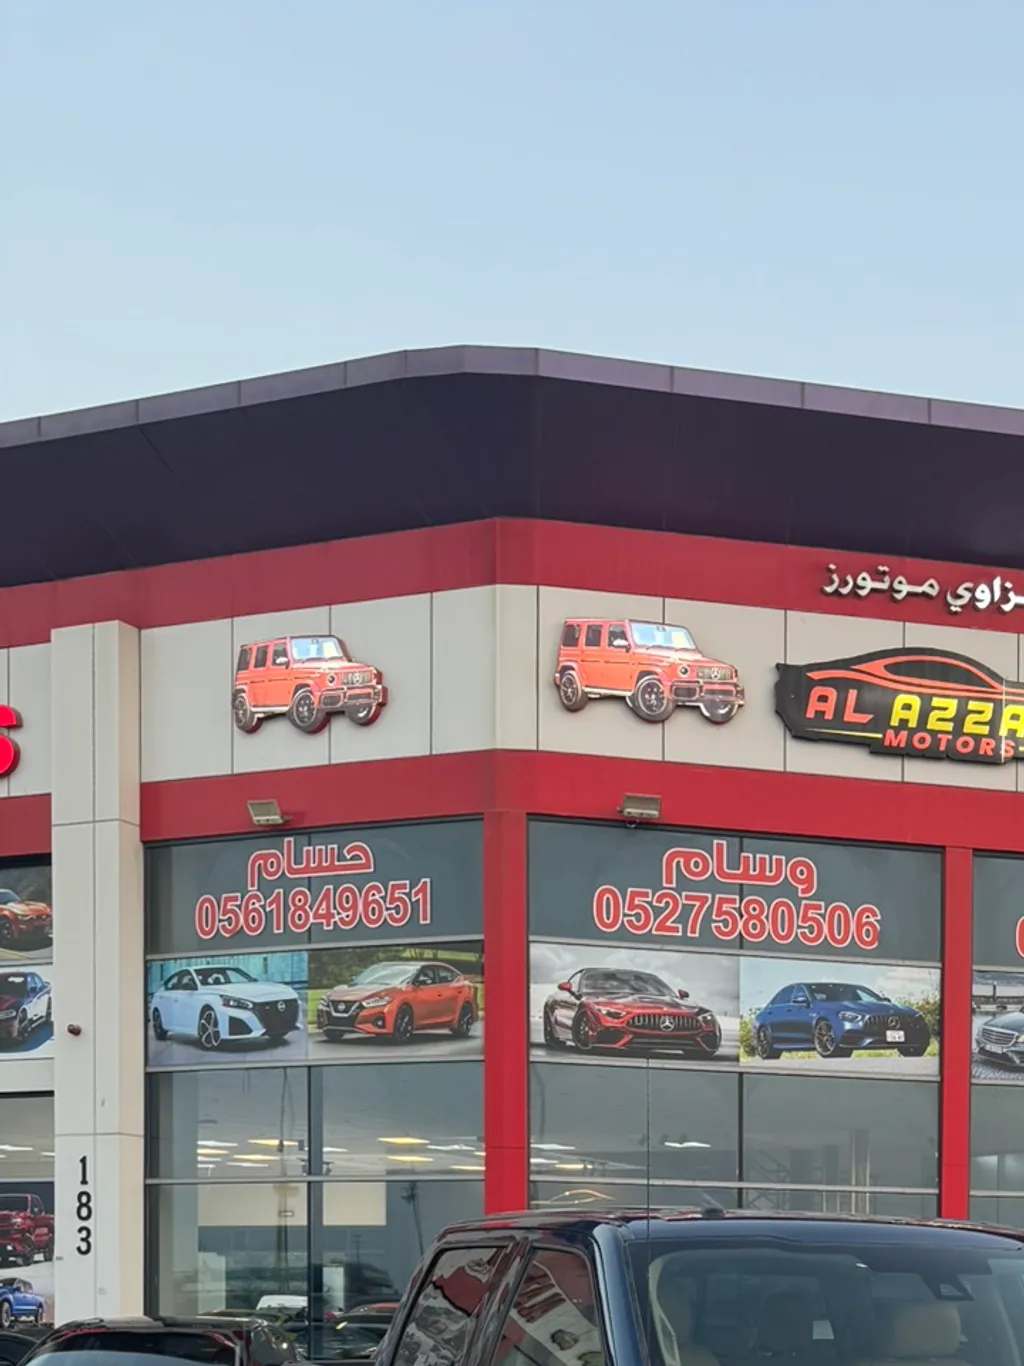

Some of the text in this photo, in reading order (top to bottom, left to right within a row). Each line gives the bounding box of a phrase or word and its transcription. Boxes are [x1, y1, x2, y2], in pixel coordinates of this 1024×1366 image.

[822, 564, 940, 600] موتورز
[805, 686, 875, 724] AL
[882, 729, 1016, 758] MOTORS
[247, 837, 374, 890] حسام
[662, 840, 817, 897] وسام
[195, 878, 431, 939] 0561849651
[593, 886, 881, 949] 0527580506
[76, 1155, 92, 1256] 183
